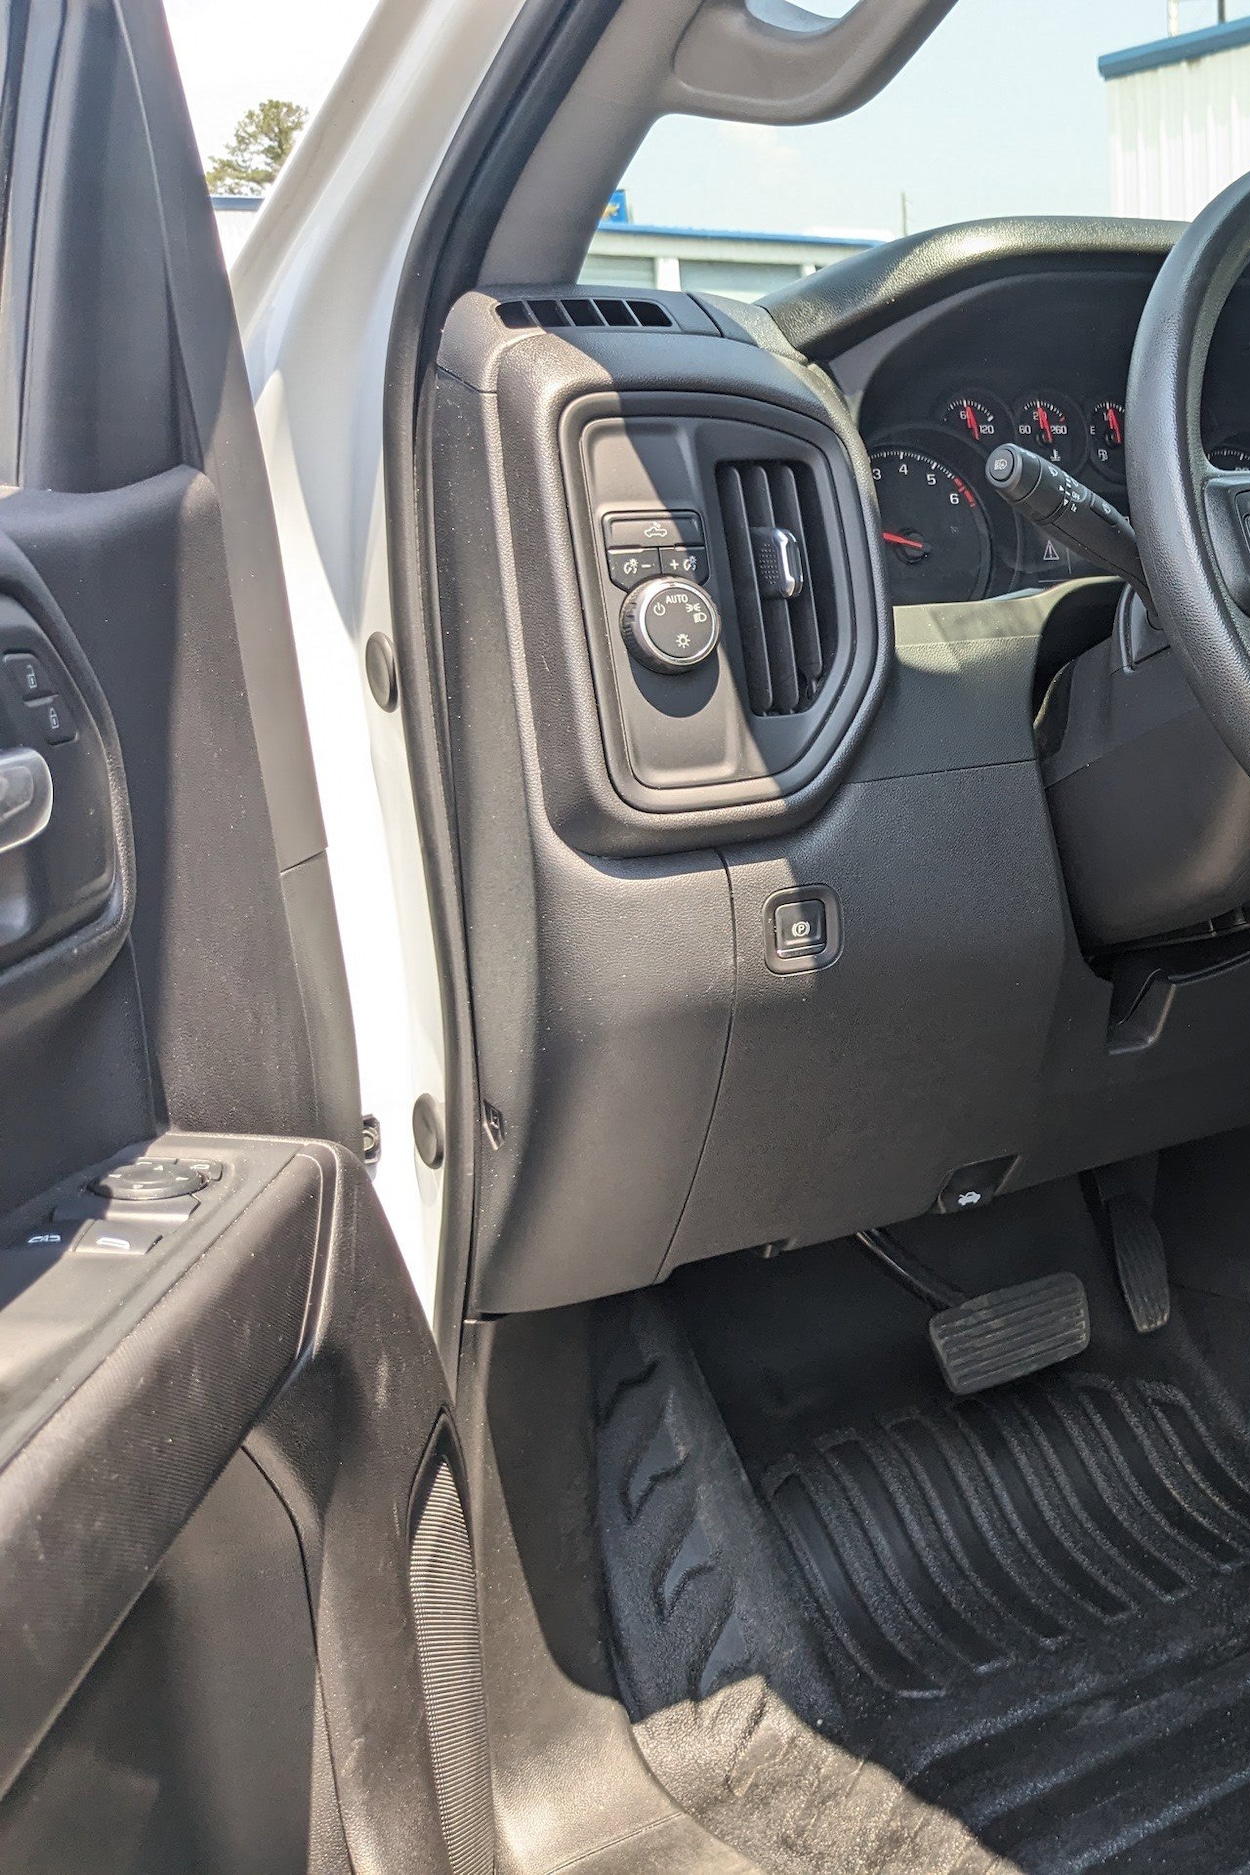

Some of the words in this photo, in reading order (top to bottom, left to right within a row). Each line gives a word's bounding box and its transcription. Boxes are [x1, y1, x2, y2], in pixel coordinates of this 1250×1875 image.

[979, 424, 995, 435] 120
[1018, 424, 1032, 435] 60
[1050, 424, 1068, 435] 260
[1090, 425, 1097, 435] E
[872, 467, 882, 481] 3
[898, 463, 909, 476] 4
[926, 473, 937, 487] 5
[949, 492, 960, 506] 6
[665, 593, 689, 605] AUTO
